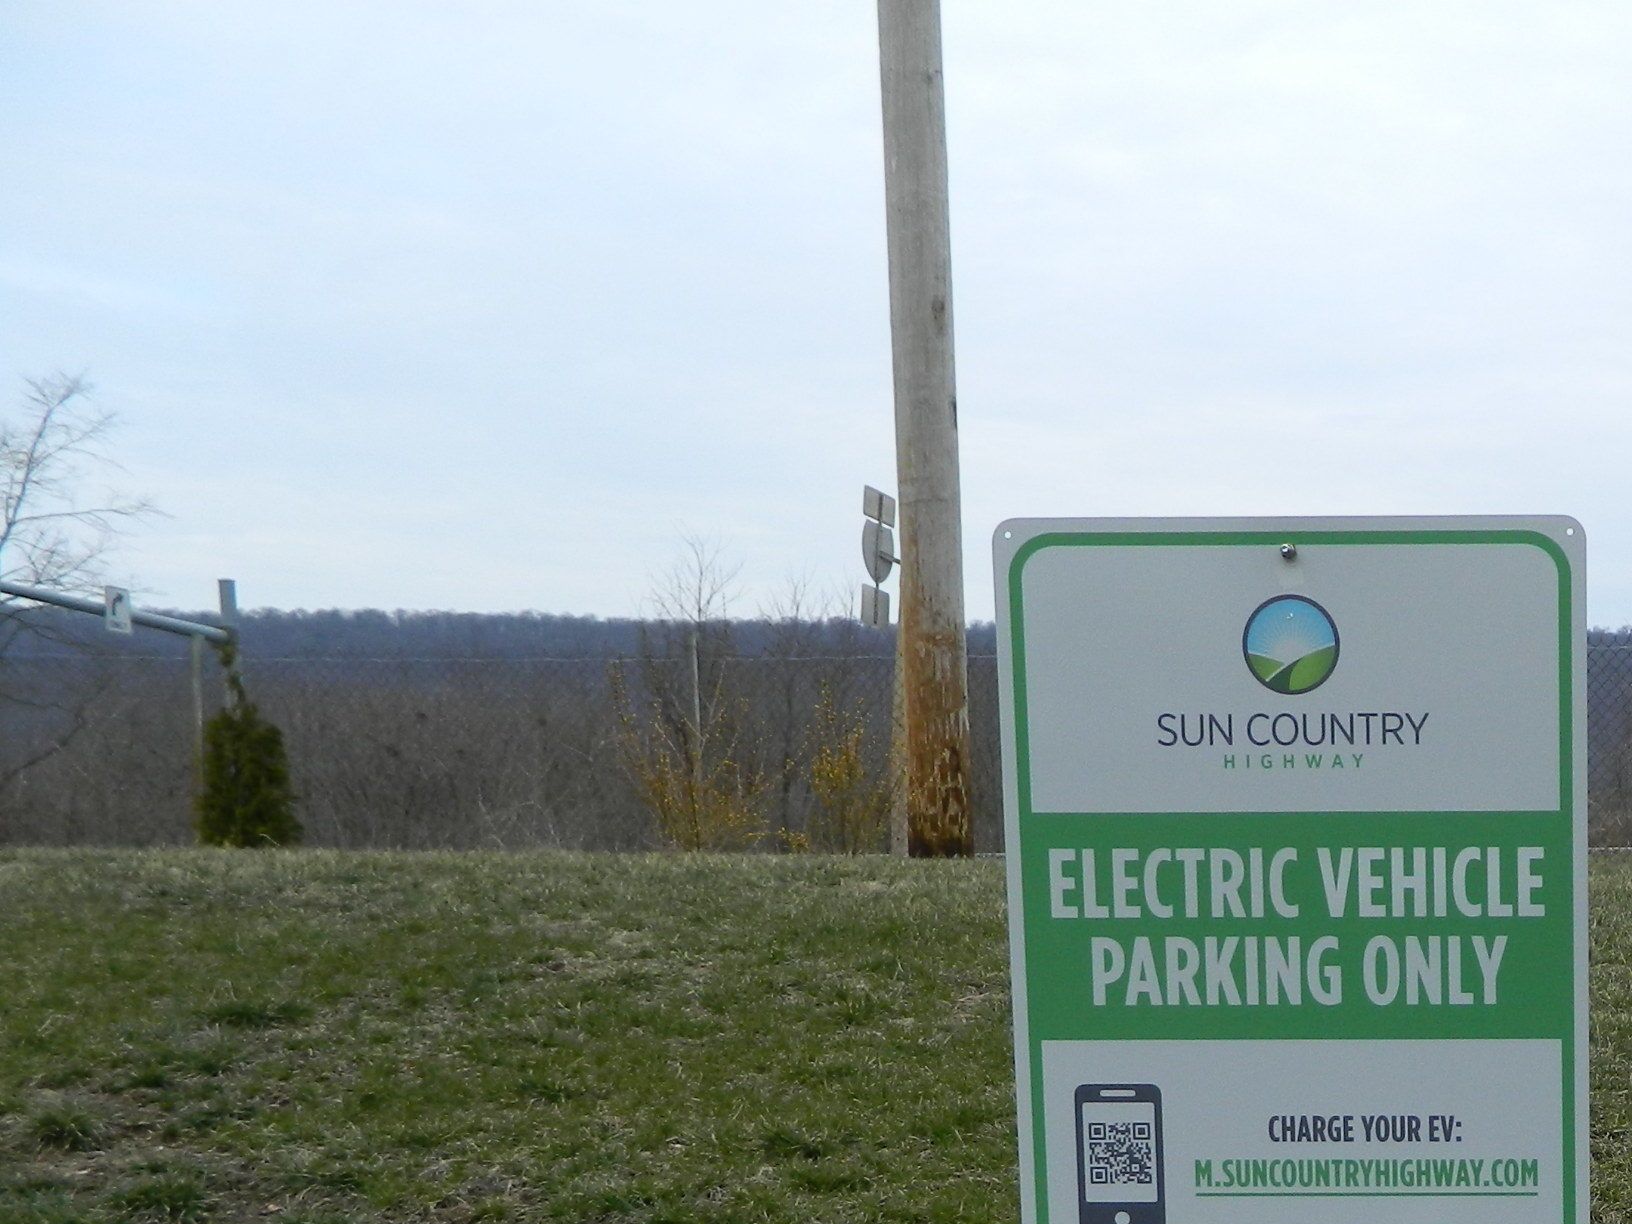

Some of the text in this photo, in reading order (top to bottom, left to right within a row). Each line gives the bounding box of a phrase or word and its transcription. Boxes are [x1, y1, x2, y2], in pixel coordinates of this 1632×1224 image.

[1157, 712, 1429, 746] SUN COUNTRY
[1223, 753, 1363, 769] HIGHWAY
[1048, 846, 1545, 918] ELECTRIC VEHICLE
[1091, 935, 1508, 1006] PARKING ONLY
[1268, 1115, 1462, 1142] CHARGE YOUR EV:
[1194, 1158, 1539, 1188] M.SUNCOUNTRYHIGHWAY.COM
